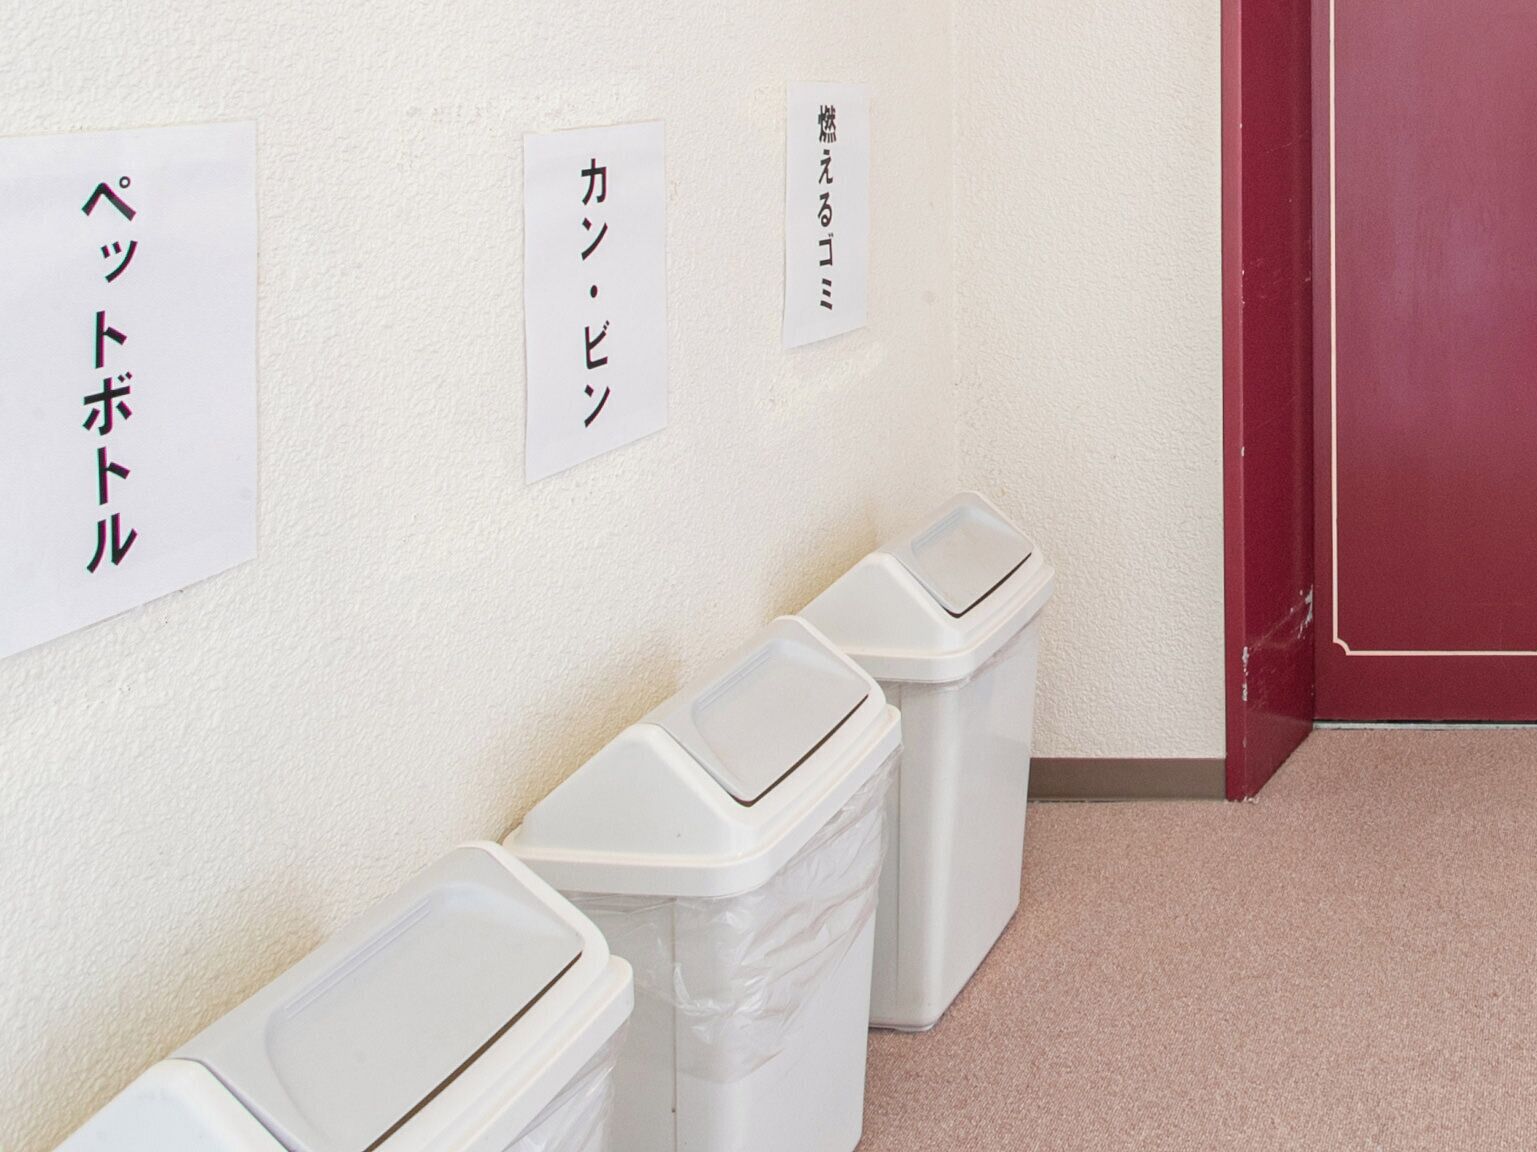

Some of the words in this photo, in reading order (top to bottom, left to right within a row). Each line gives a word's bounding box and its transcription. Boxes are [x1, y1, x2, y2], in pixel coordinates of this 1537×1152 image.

[581, 158, 610, 427] カン・ビン
[818, 105, 836, 310] 燃えるゴミ
[82, 176, 137, 573] ペットボトル
